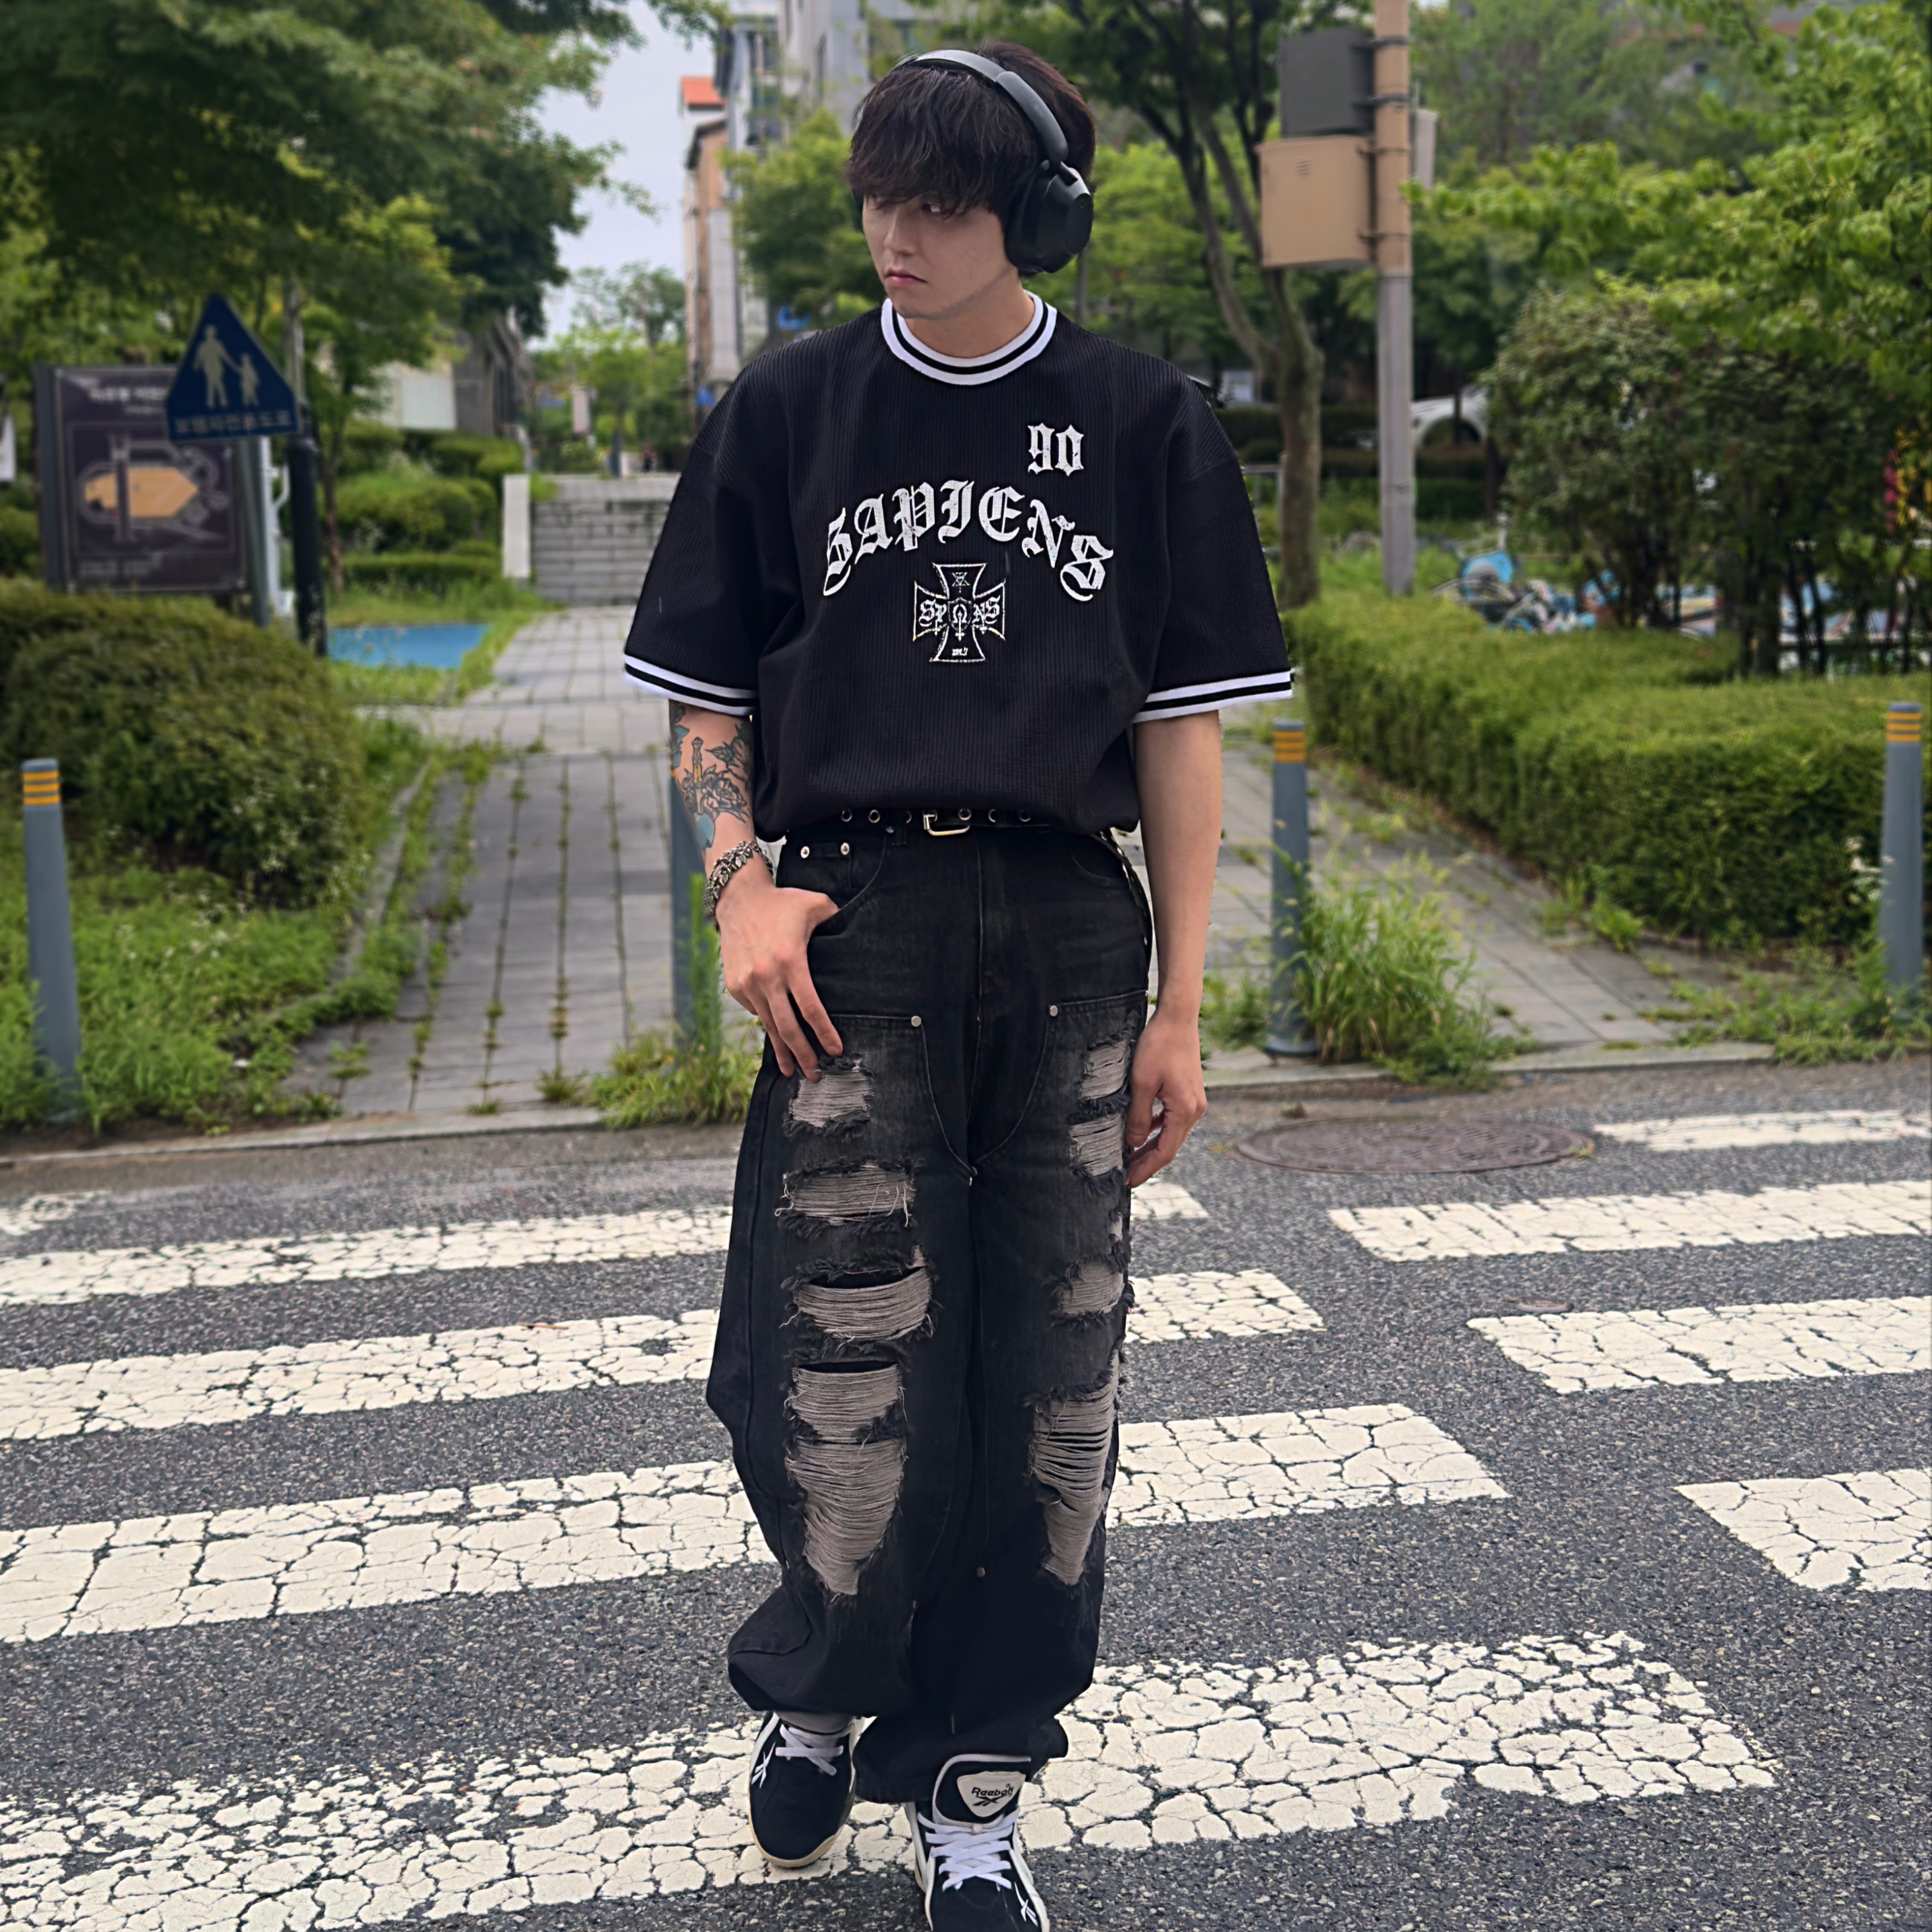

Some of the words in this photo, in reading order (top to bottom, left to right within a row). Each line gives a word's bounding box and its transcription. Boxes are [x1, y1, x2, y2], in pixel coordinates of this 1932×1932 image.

[1028, 423, 1084, 476] 90
[823, 480, 1114, 601] SAPIENS
[971, 1786, 1014, 1796] Reebok
